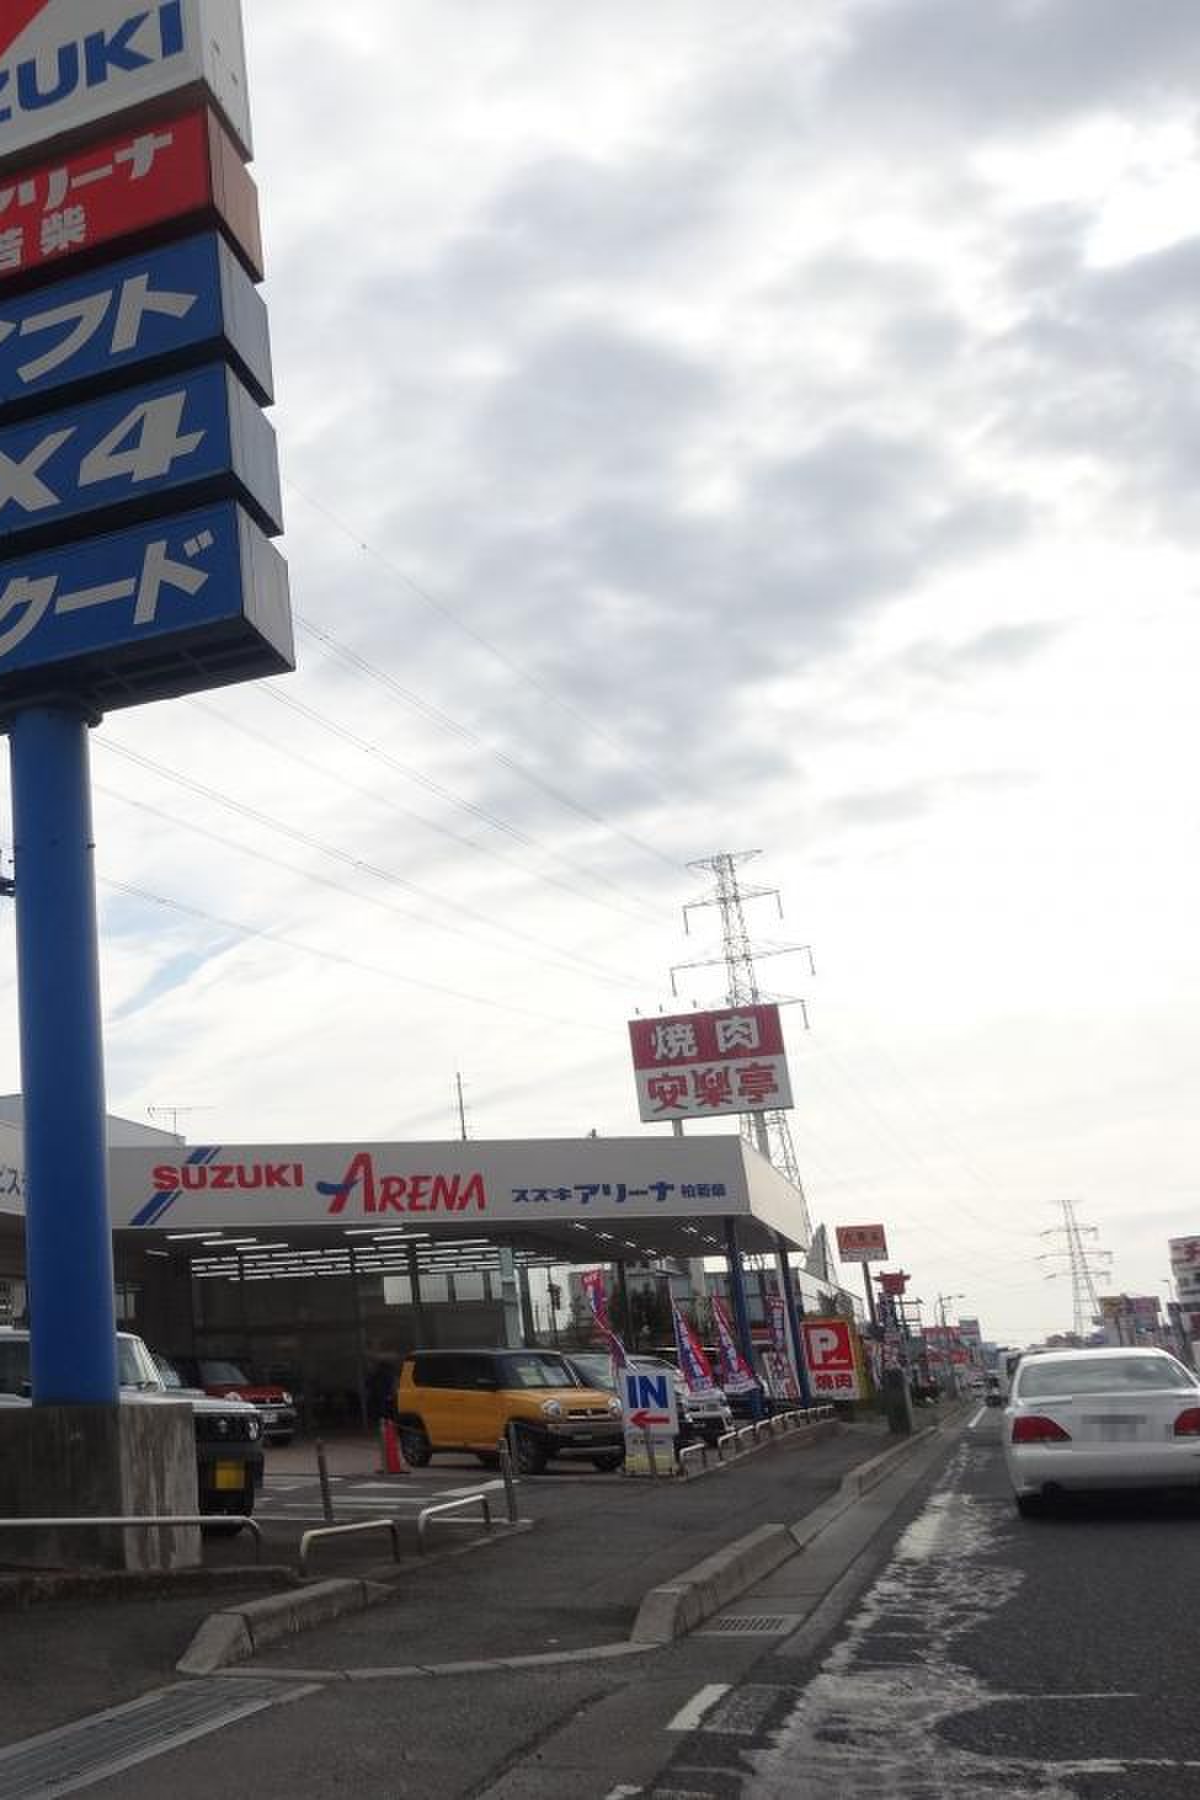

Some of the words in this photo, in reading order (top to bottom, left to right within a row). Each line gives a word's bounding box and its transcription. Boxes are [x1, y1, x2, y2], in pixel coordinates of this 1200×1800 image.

[652, 1015, 760, 1060] 焼肉
[647, 1061, 779, 1114] 安楽亭
[152, 1163, 304, 1191] SUZUKI
[316, 1152, 486, 1214] ARENA
[808, 1328, 840, 1365] P
[625, 1375, 669, 1409] IN
